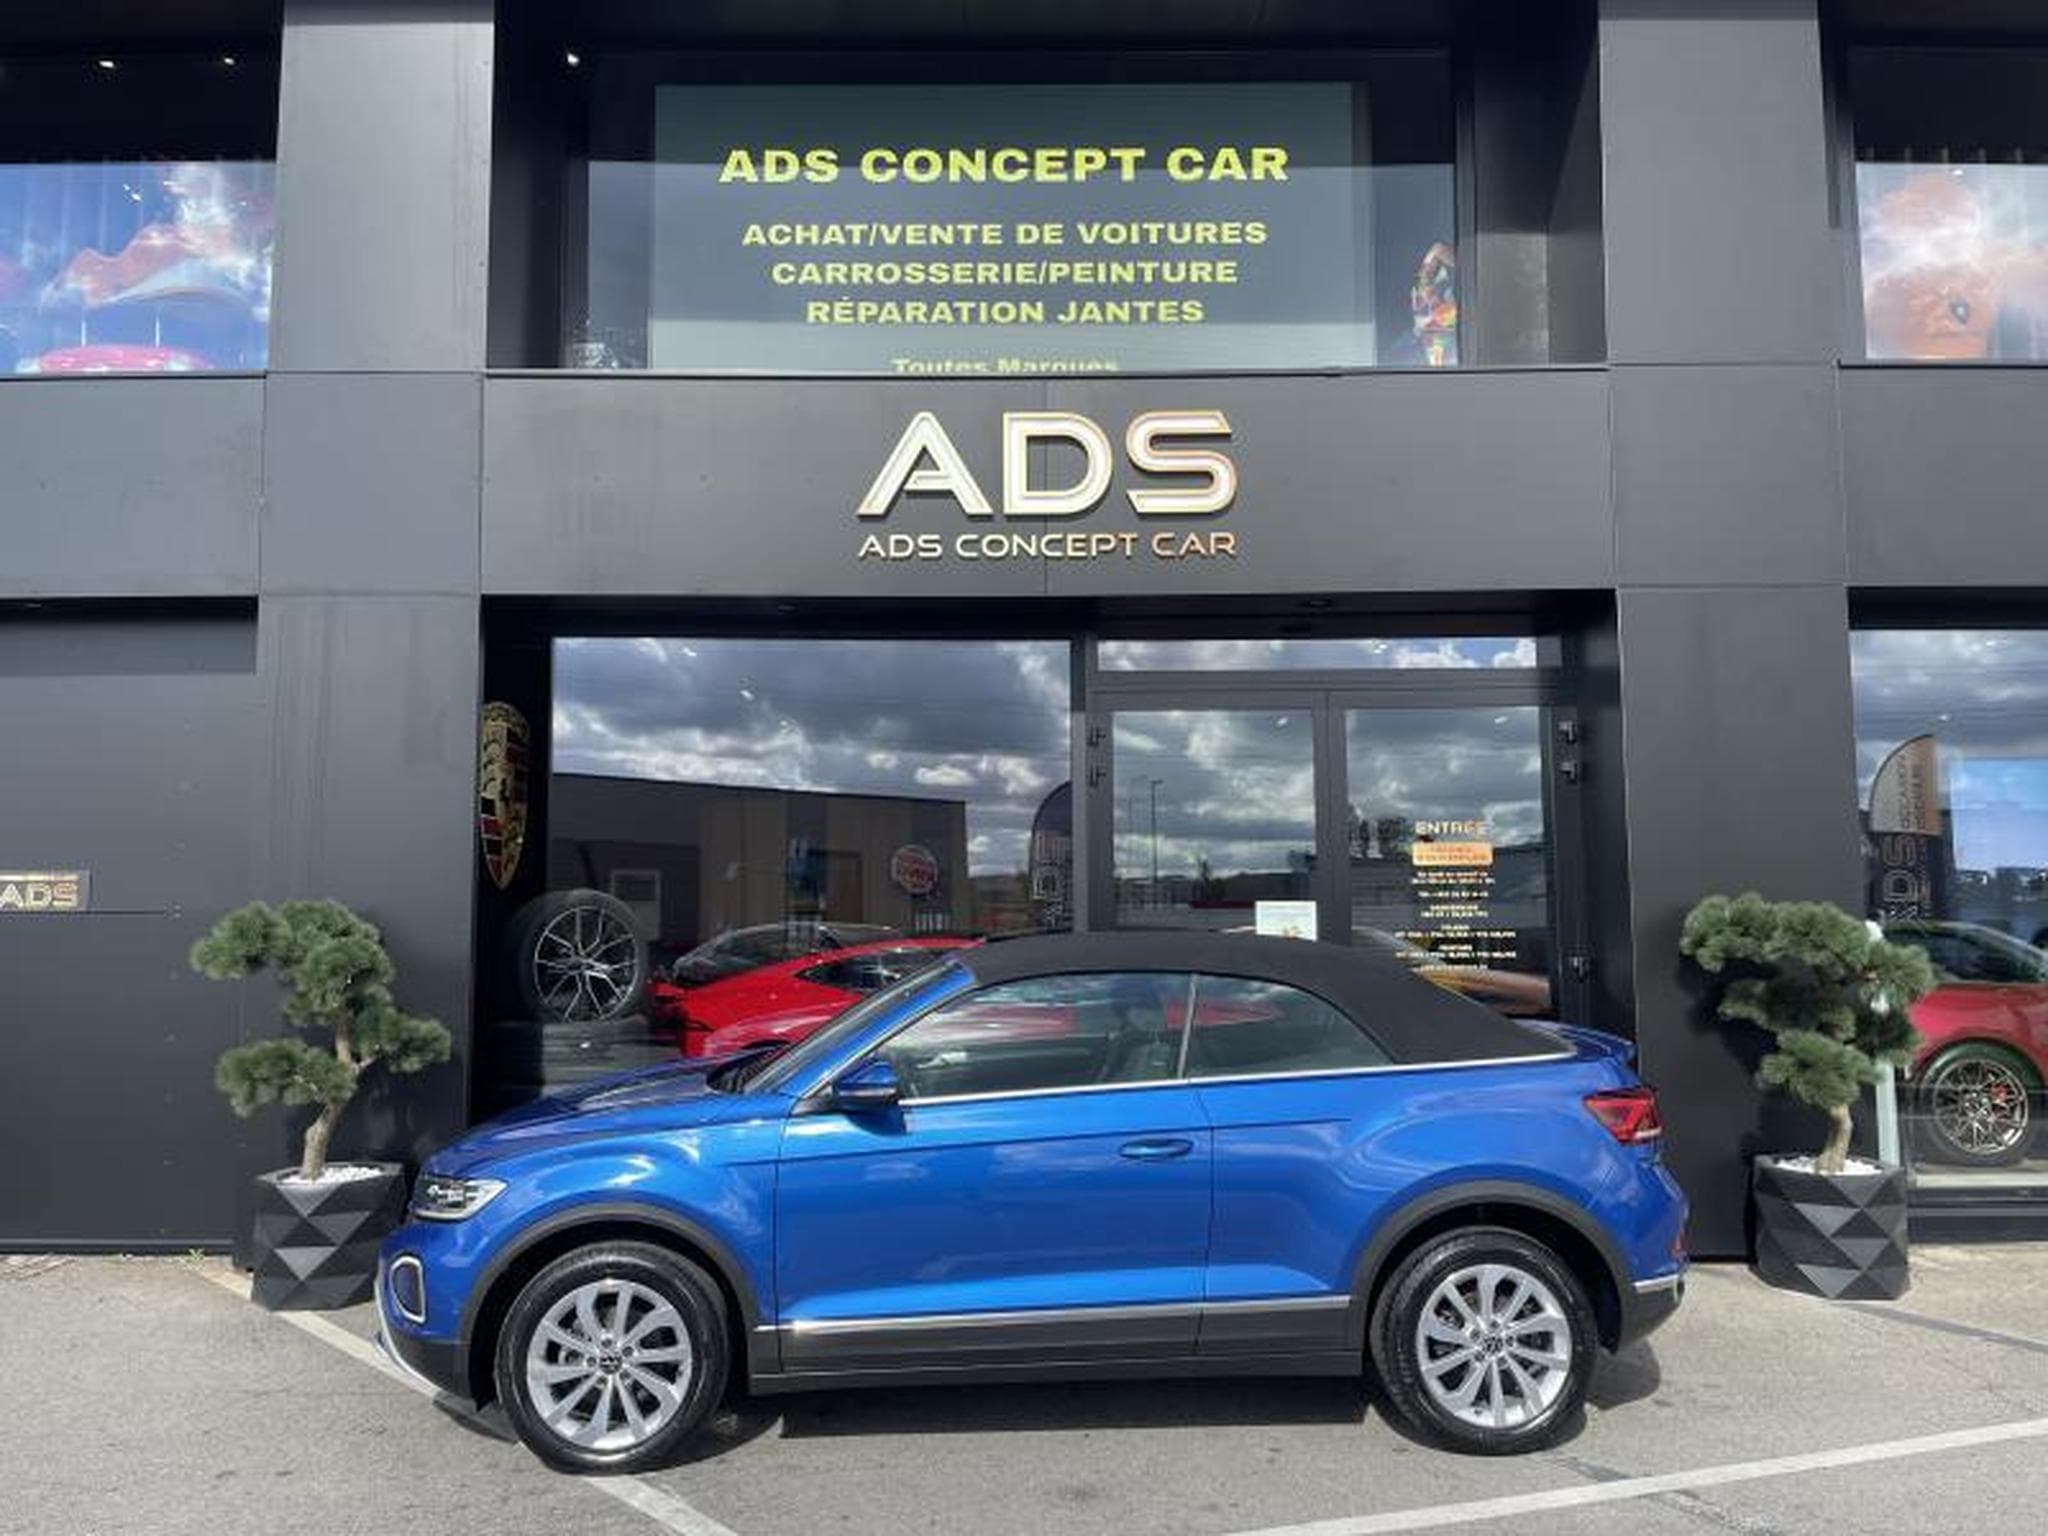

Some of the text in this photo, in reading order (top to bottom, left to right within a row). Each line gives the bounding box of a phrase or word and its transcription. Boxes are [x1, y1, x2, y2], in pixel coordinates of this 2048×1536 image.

[720, 145, 1289, 184] ADS CONCEPT CAR
[742, 221, 1268, 247] ACHAT/VENTE DE VOITURES
[771, 261, 1239, 285] CARROSSERIE/PEINTURE
[806, 296, 1205, 324] RÉPARATION JANTES
[891, 358, 988, 373] Toutes
[856, 410, 1238, 515] ADS
[858, 532, 1237, 558] ADS CONCEPT CAR
[0, 882, 78, 908] ADS
